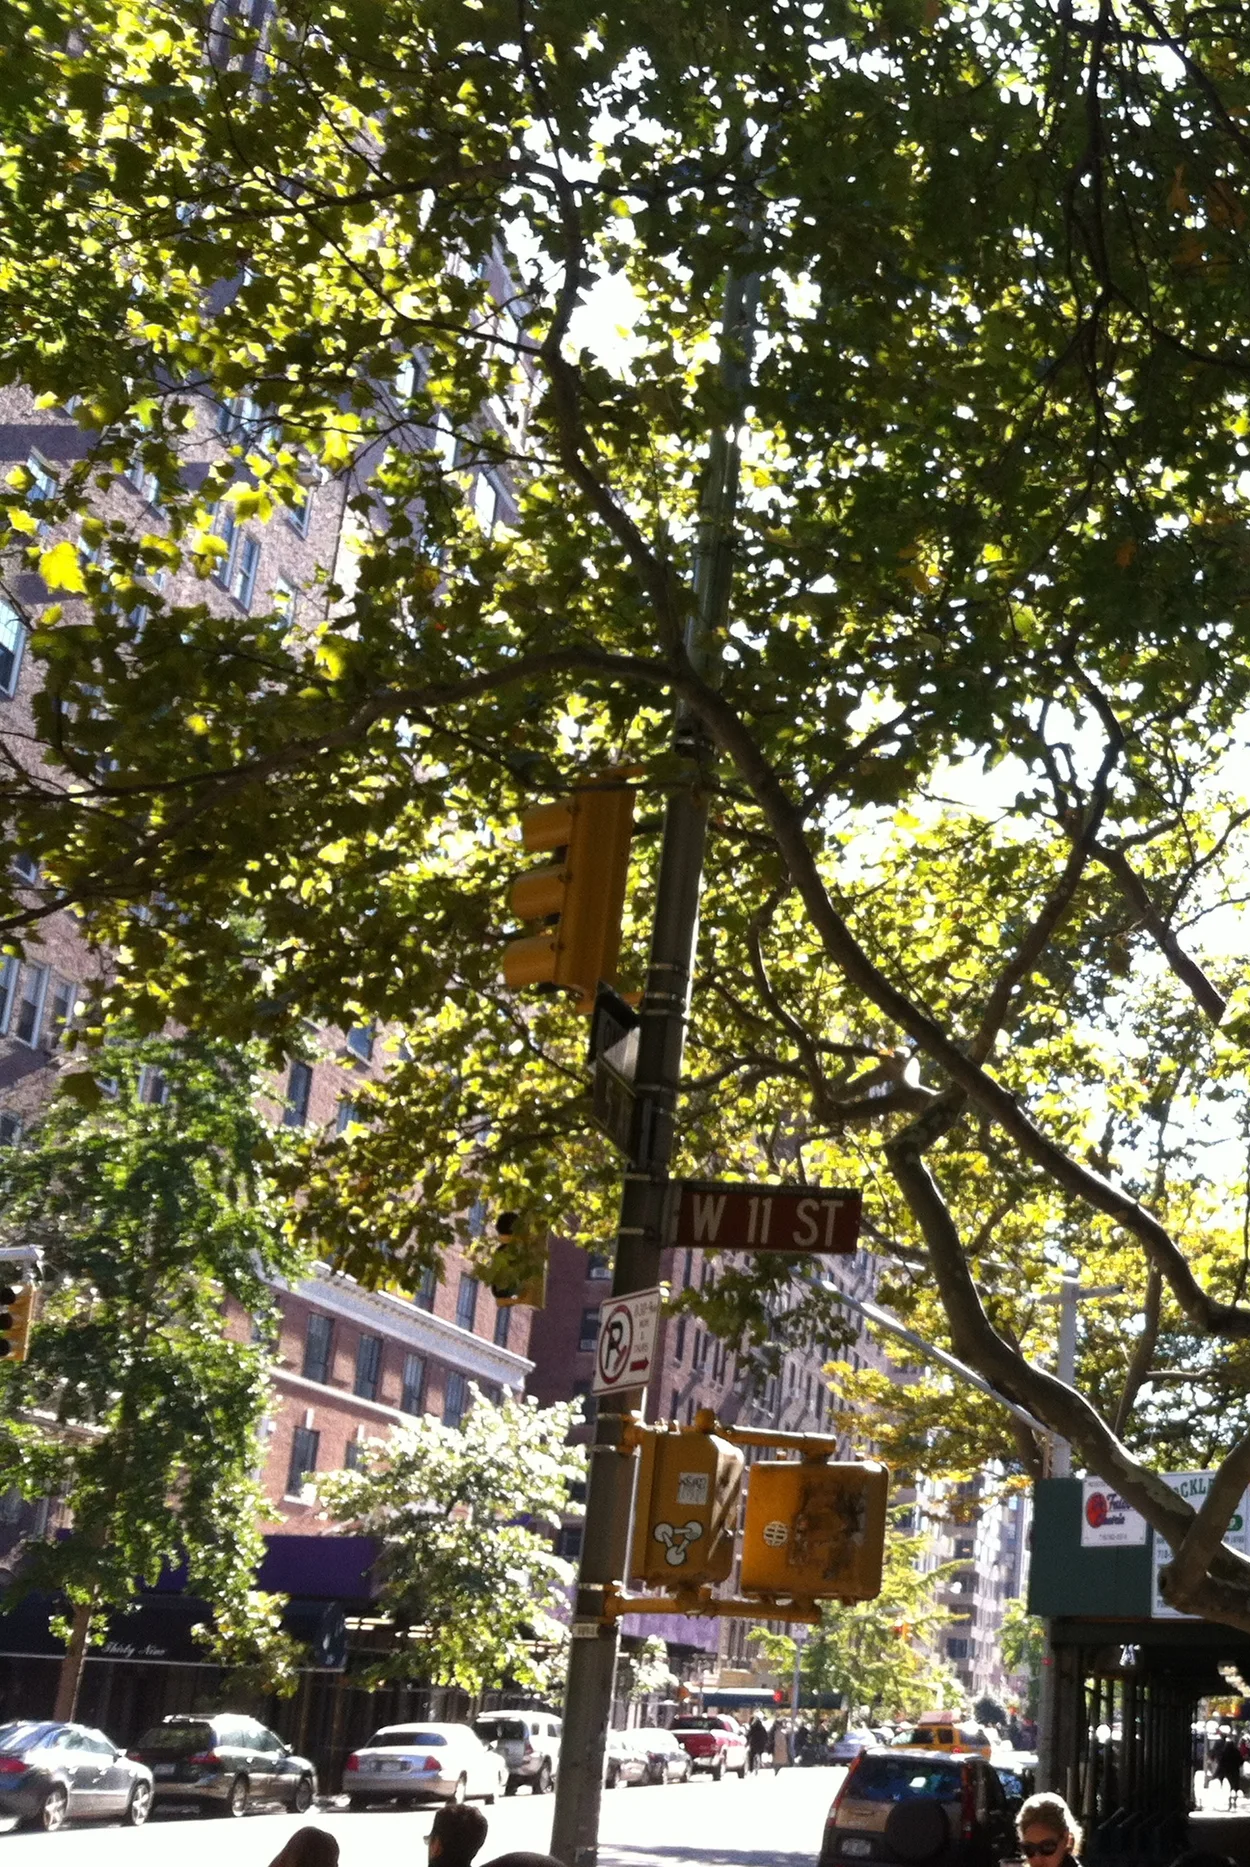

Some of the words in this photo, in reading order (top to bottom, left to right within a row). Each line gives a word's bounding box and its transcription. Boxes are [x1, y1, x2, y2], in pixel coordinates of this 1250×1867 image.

[693, 1193, 727, 1242] W
[747, 1196, 773, 1245] 11
[792, 1198, 844, 1248] ST
[101, 1641, 136, 1659] Thirty
